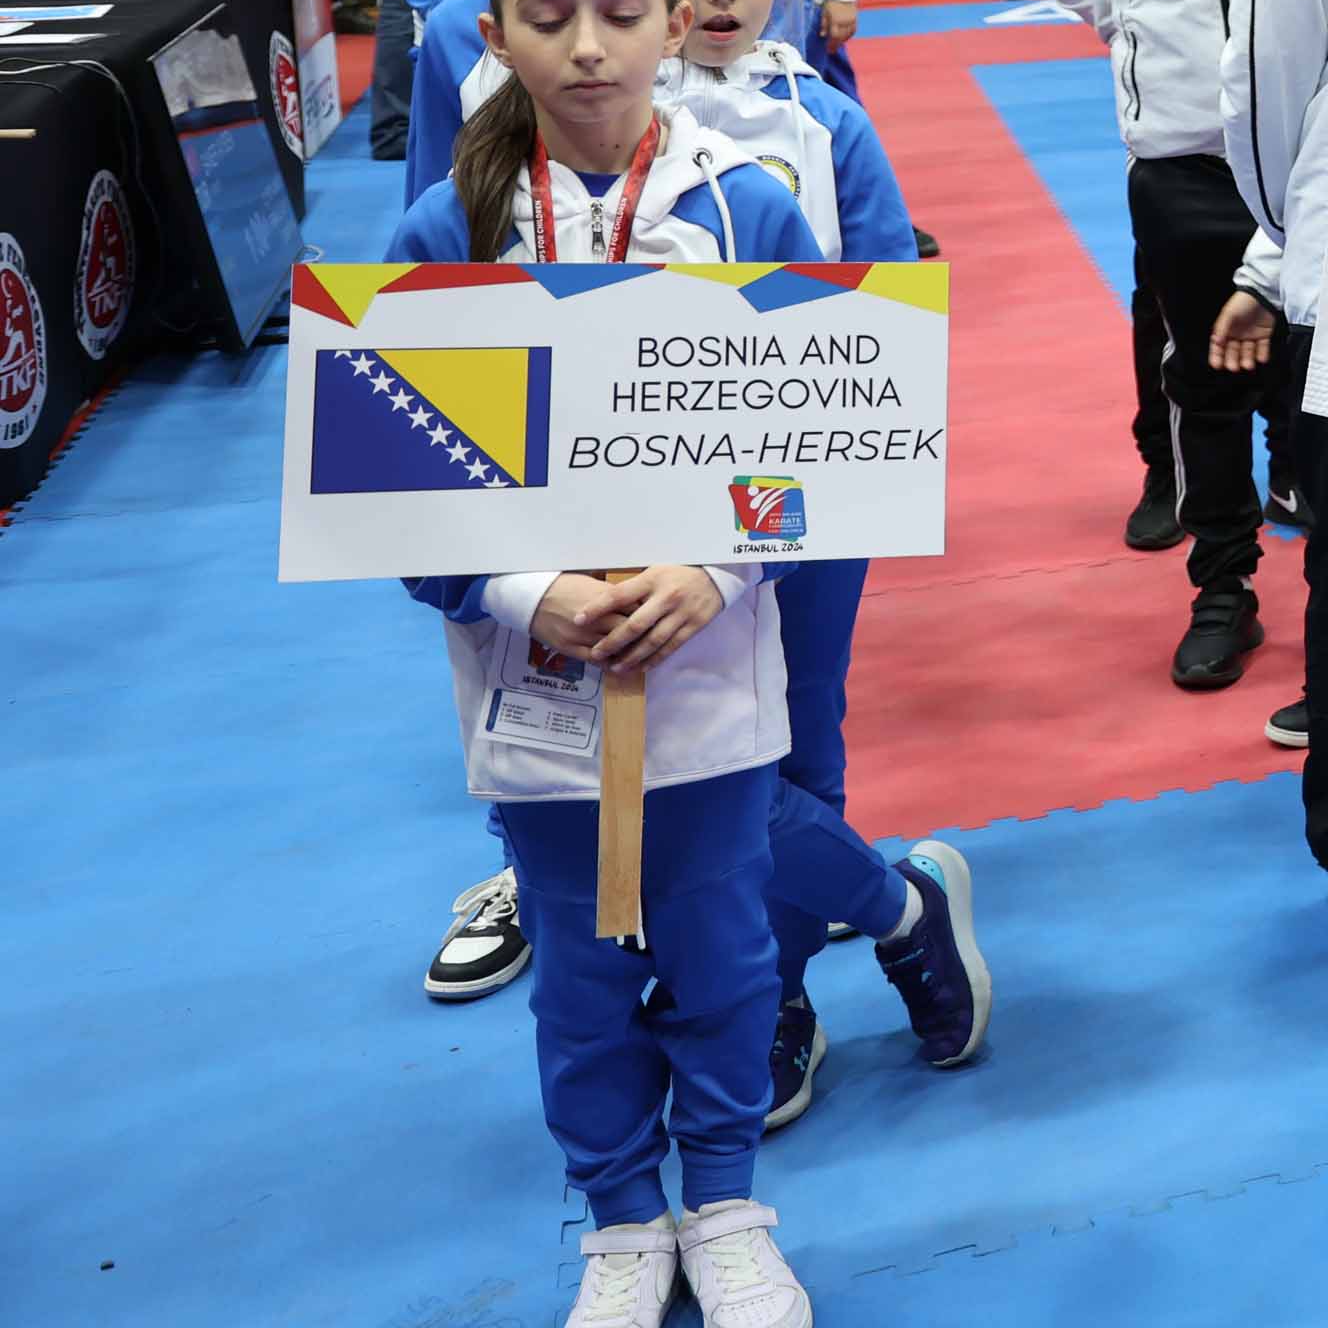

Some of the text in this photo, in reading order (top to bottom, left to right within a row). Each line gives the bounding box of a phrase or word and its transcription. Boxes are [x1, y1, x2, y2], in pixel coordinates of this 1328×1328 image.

[534, 199, 545, 234] CHILDREN
[536, 235, 546, 248] FOR
[637, 334, 881, 370] BOSNIA AND
[612, 375, 903, 414] HERZEGOVINA
[568, 427, 945, 470] BOSNA-HERSEK
[768, 517, 802, 525] KARATE
[732, 542, 803, 554] ISTANBUL 2024
